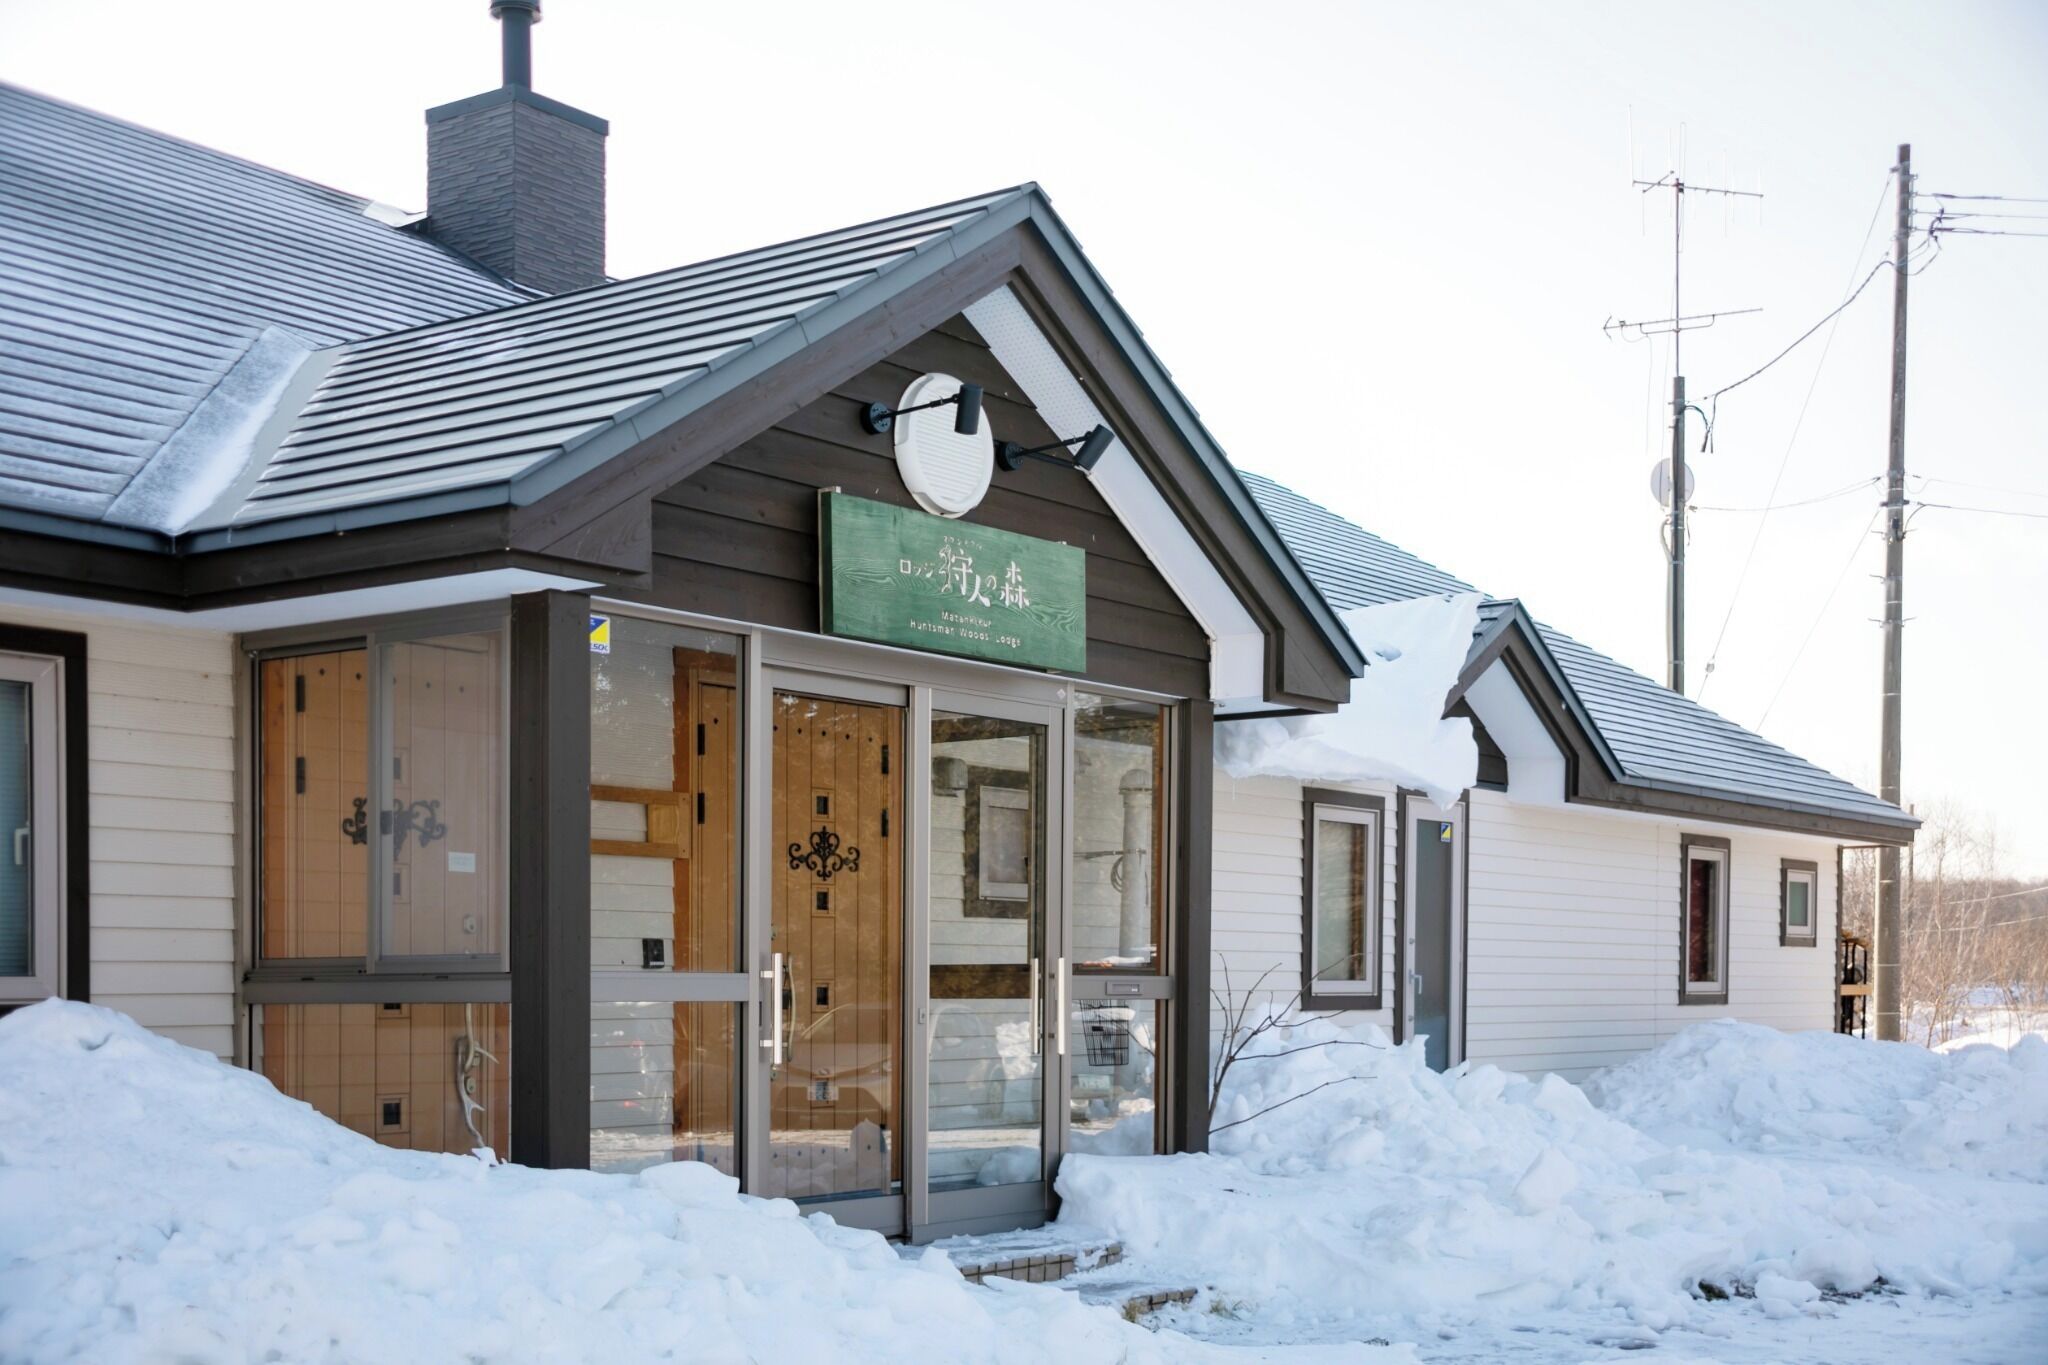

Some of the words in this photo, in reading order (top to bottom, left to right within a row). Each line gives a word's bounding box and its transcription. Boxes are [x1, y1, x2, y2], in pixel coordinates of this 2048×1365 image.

[910, 619, 955, 635] Huntsman
[959, 627, 990, 641] Woods
[995, 634, 1021, 648] Lodge
